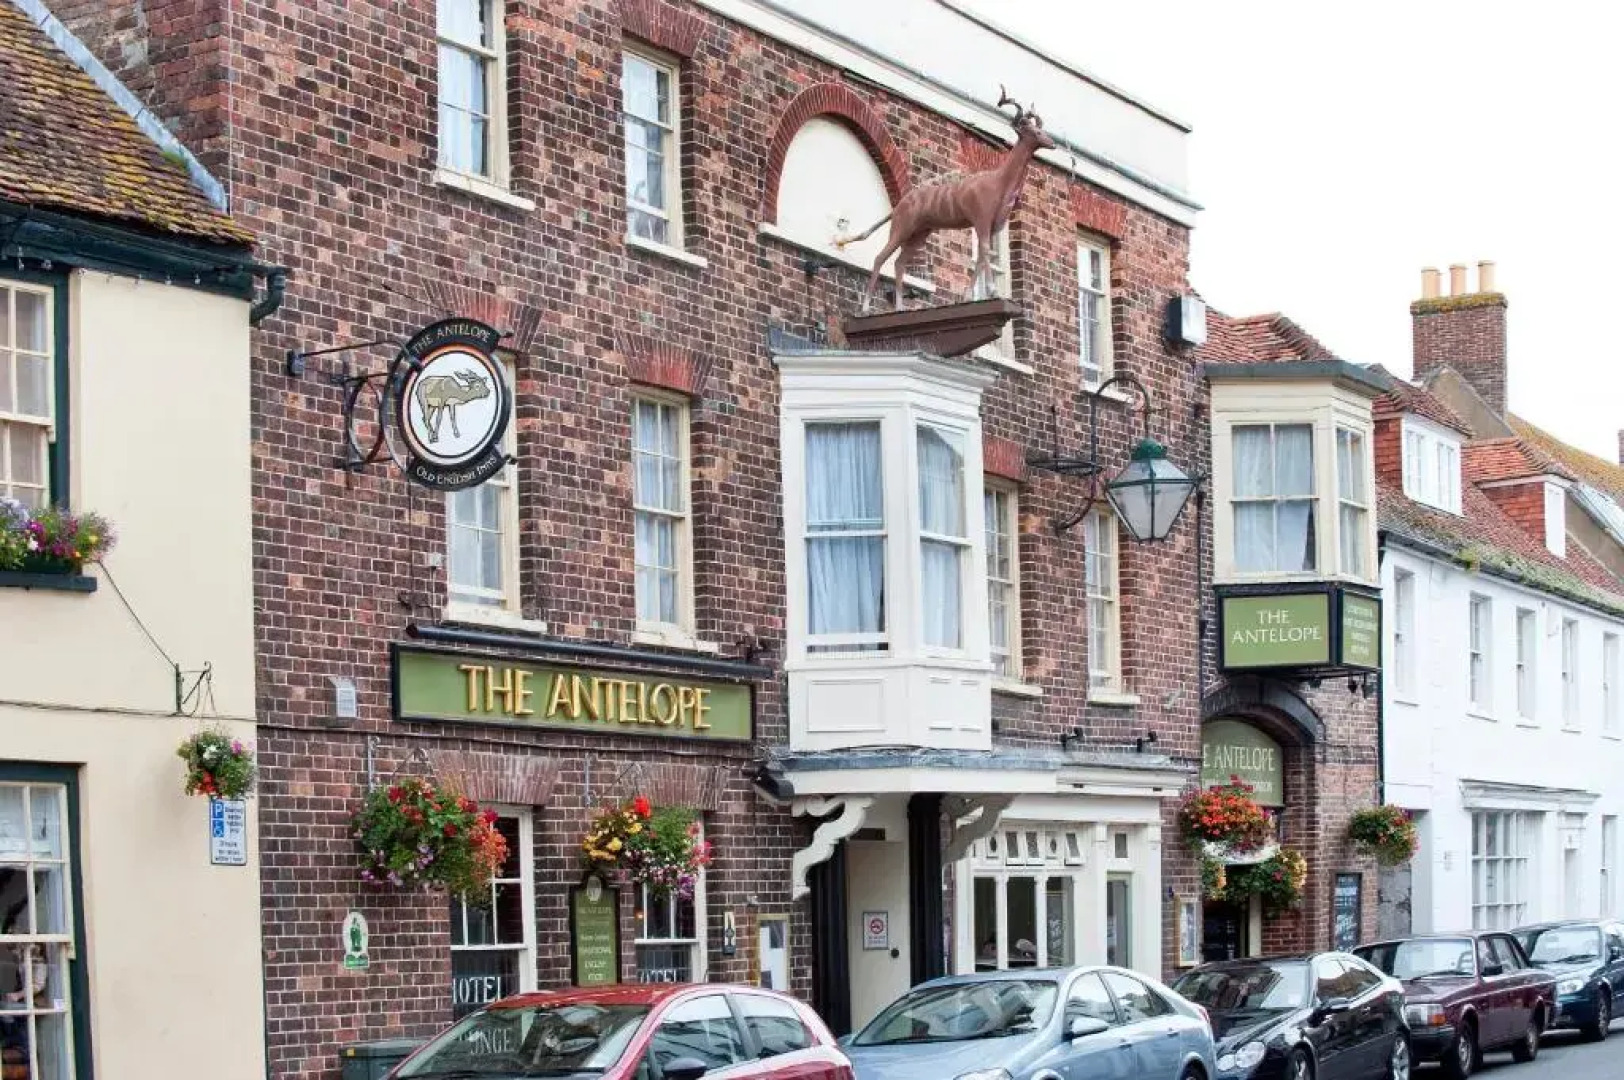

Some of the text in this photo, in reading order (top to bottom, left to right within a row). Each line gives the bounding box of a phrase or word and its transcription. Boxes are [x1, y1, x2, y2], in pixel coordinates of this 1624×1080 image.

[411, 324, 491, 354] THE ANTELOPE
[1256, 608, 1290, 625] THE
[1231, 626, 1322, 645] ANTELOPE
[458, 663, 712, 730] THE ANTELOPE
[1214, 744, 1276, 772] ANTELOPE
[215, 803, 224, 818] P
